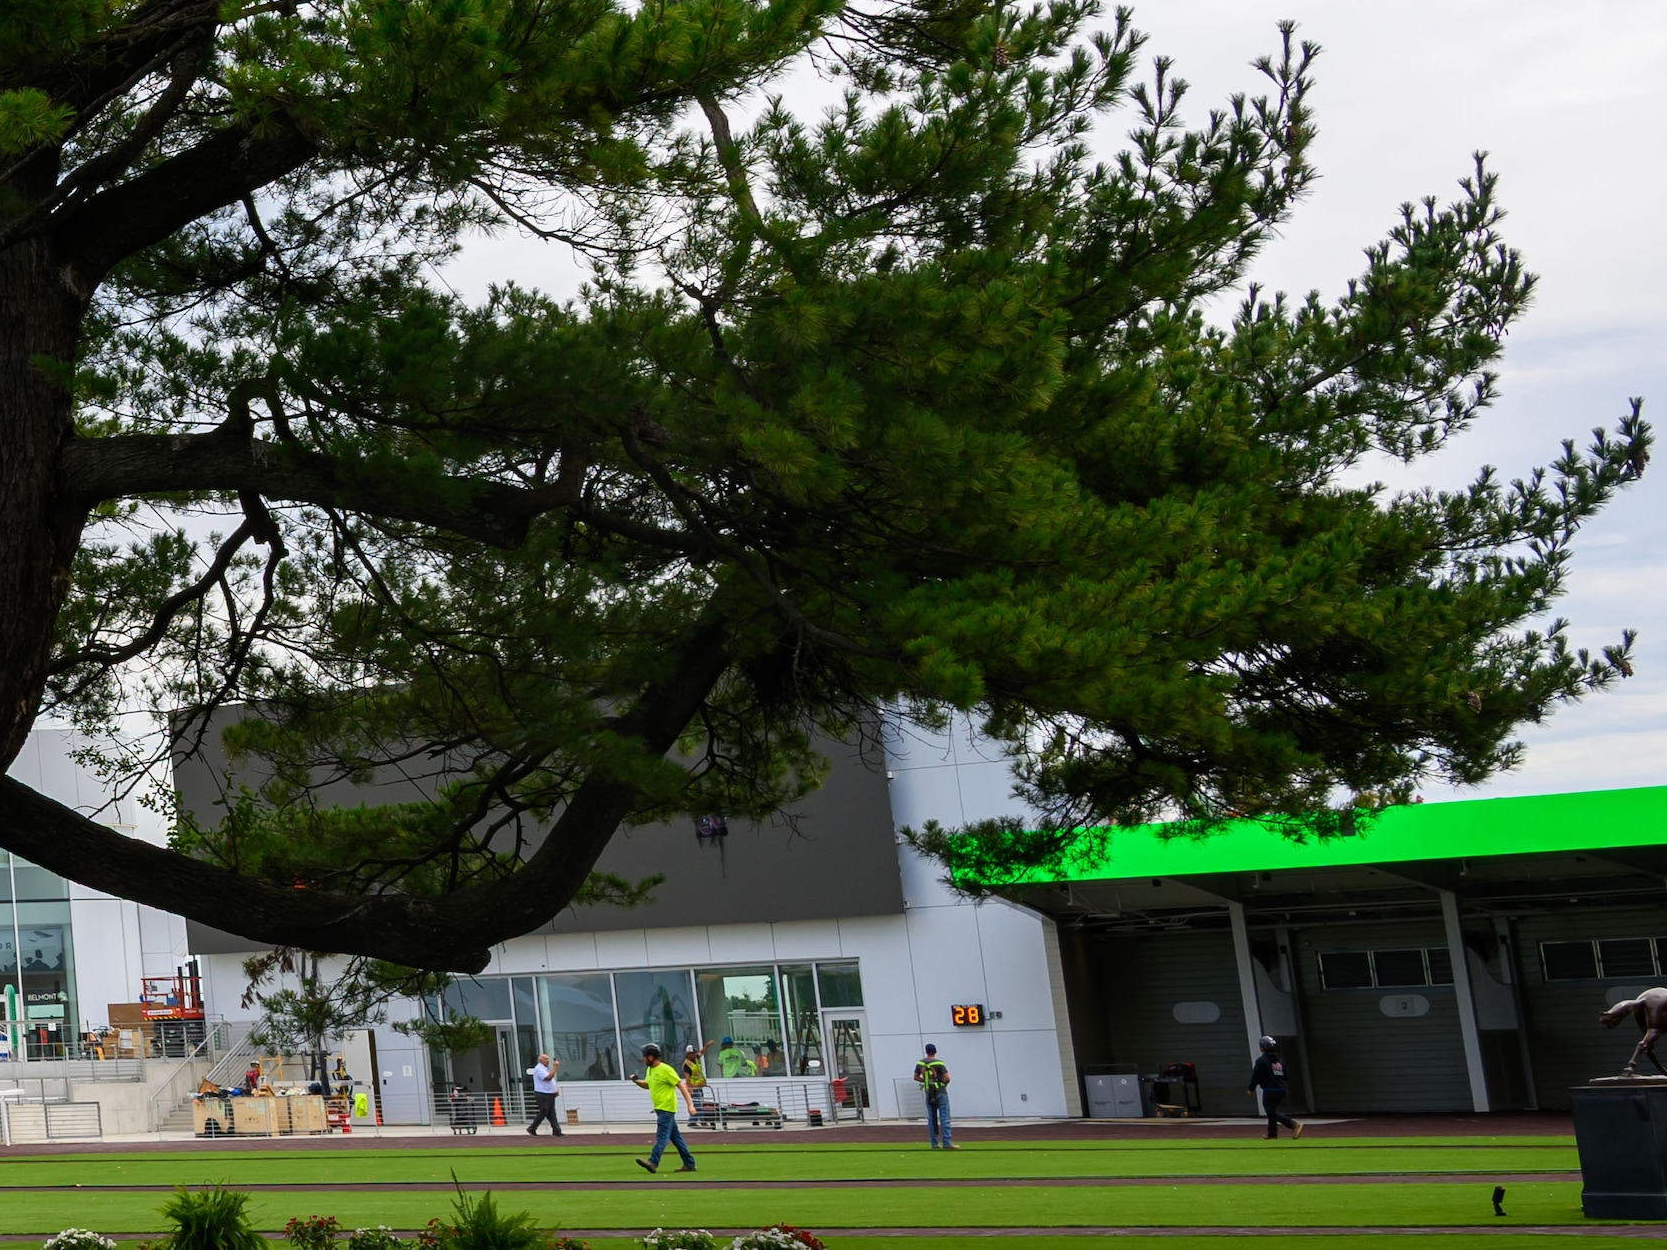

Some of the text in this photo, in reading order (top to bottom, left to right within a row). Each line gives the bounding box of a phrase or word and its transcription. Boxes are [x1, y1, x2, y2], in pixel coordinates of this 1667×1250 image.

[27, 993, 56, 1001] BELMONT
[1401, 1001, 1408, 1010] 2
[954, 1006, 979, 1025] 28
